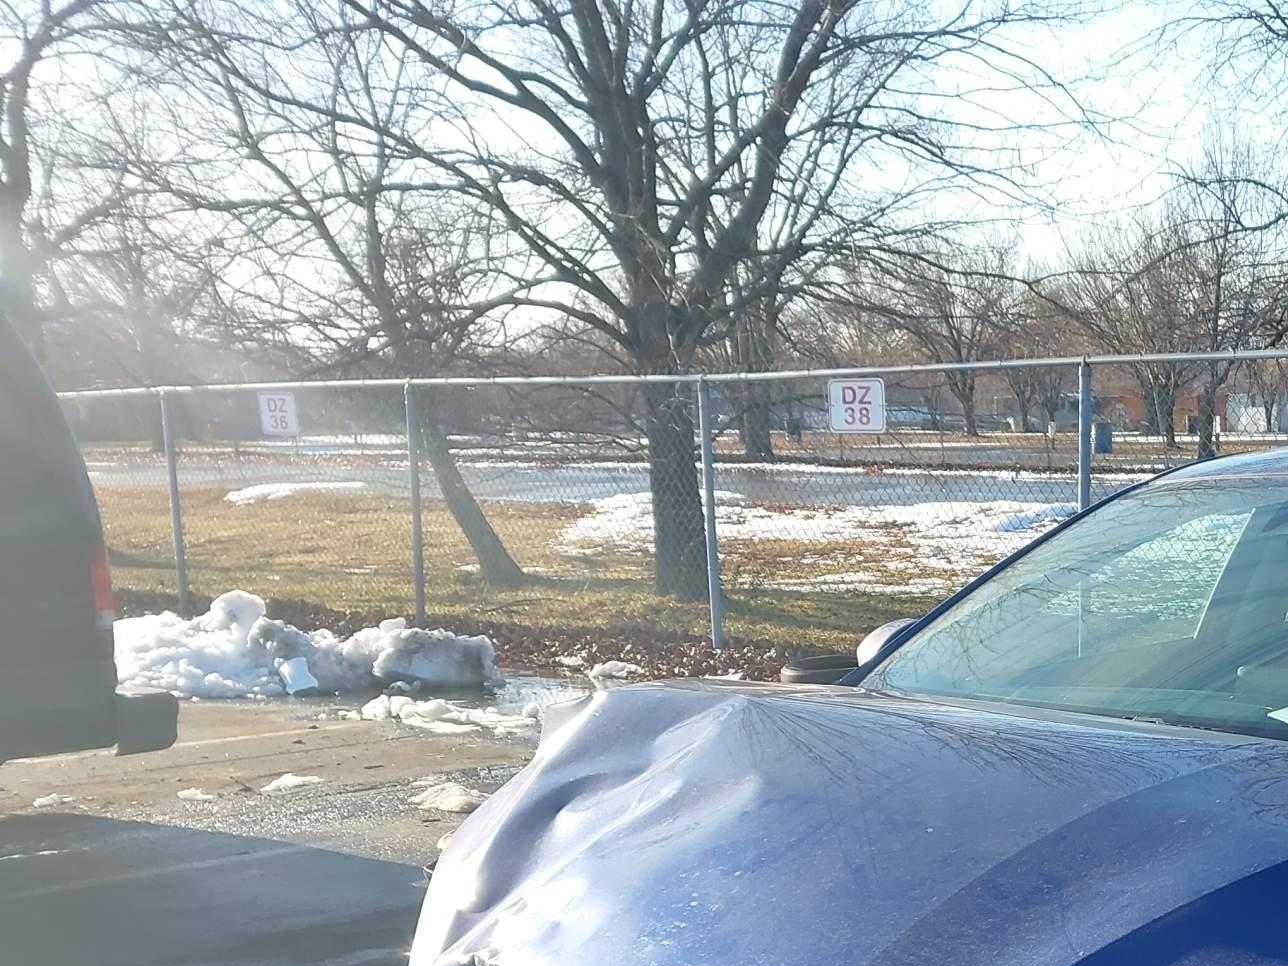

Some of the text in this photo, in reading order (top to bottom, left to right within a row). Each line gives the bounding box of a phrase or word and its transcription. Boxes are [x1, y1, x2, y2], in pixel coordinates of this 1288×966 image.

[842, 386, 872, 405] DZ
[267, 398, 288, 413] DZ
[270, 415, 289, 430] 36
[844, 407, 871, 425] 38
